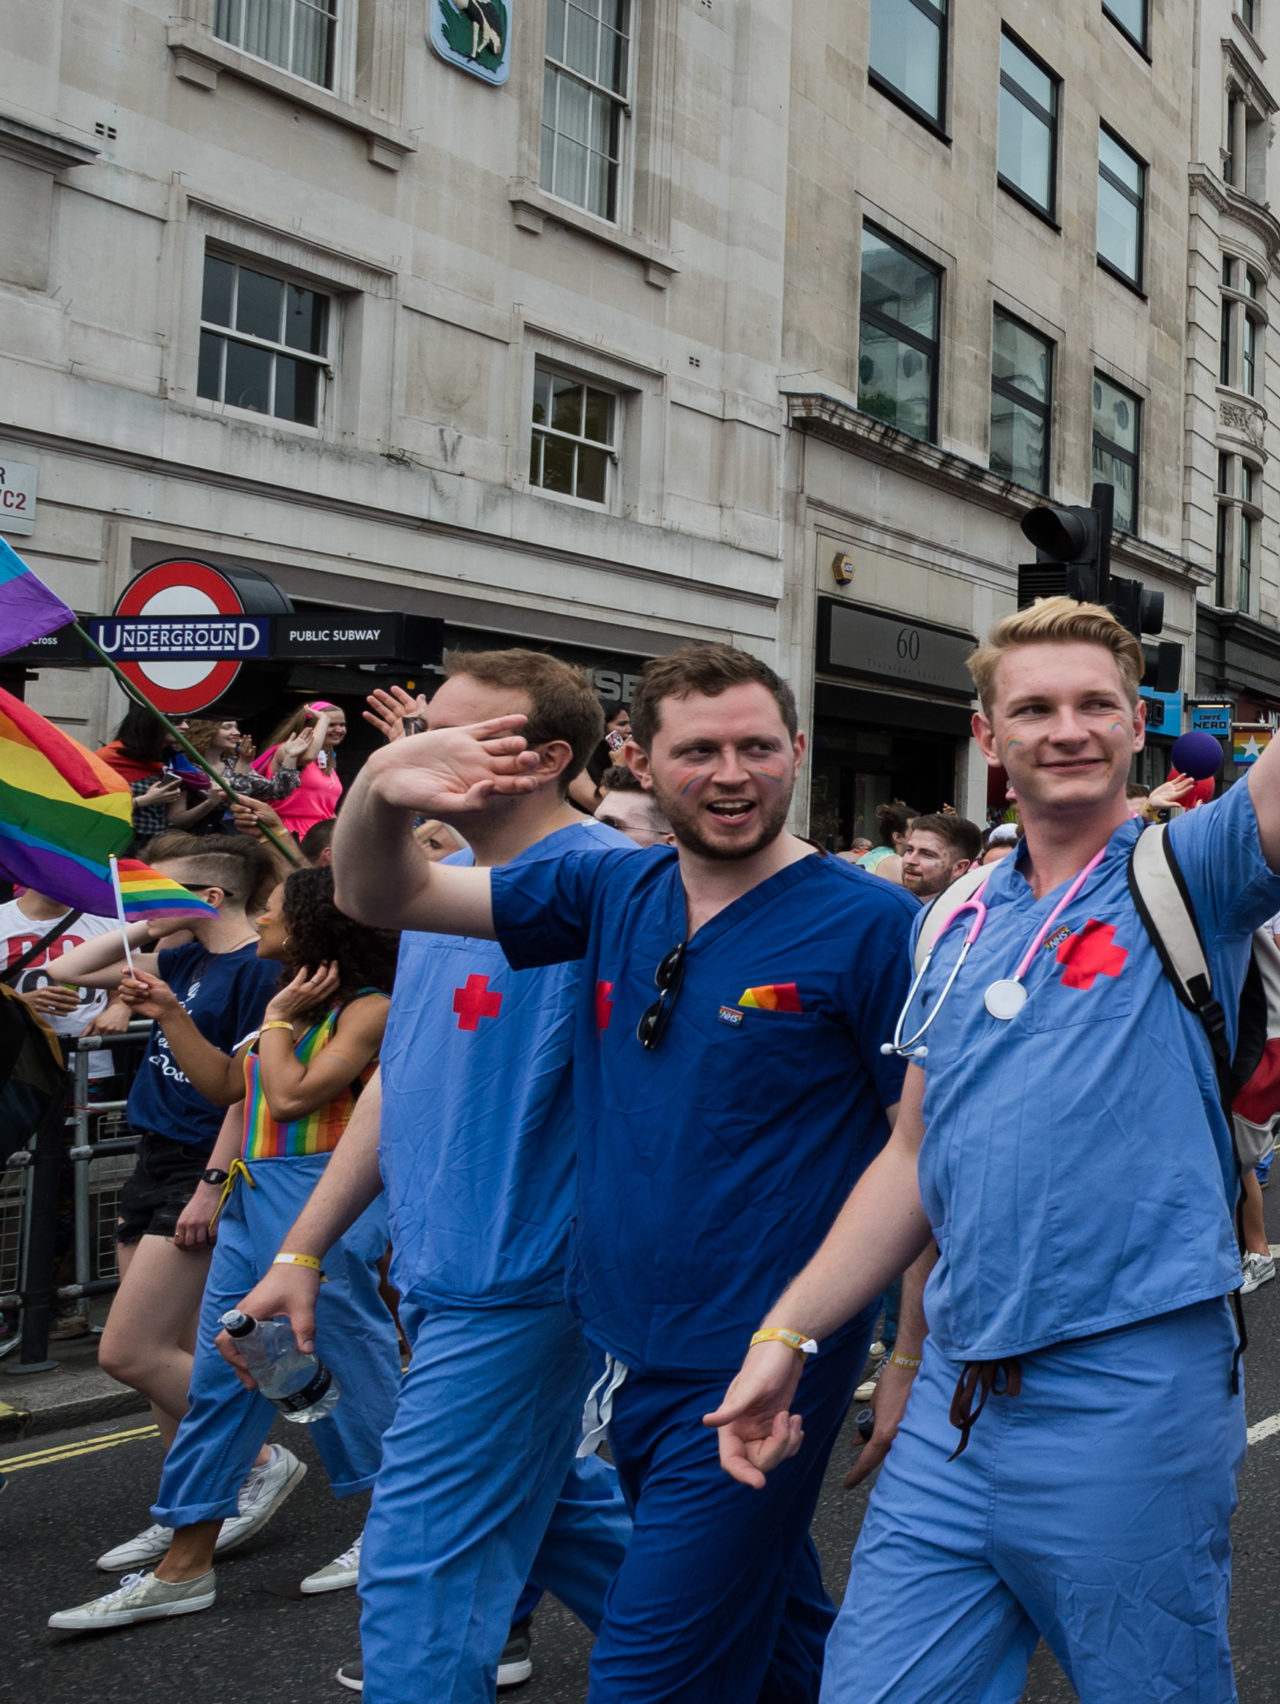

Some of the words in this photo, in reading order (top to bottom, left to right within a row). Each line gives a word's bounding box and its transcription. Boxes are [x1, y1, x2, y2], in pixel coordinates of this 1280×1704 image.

[0, 488, 26, 511] C2
[99, 623, 260, 653] UNDERGROUND
[289, 630, 332, 641] PUBLIC
[332, 629, 381, 641] SUBWAY
[897, 628, 920, 661] 60
[1193, 721, 1227, 729] NERO
[1049, 930, 1069, 949] NHS
[720, 1011, 739, 1023] NHS
